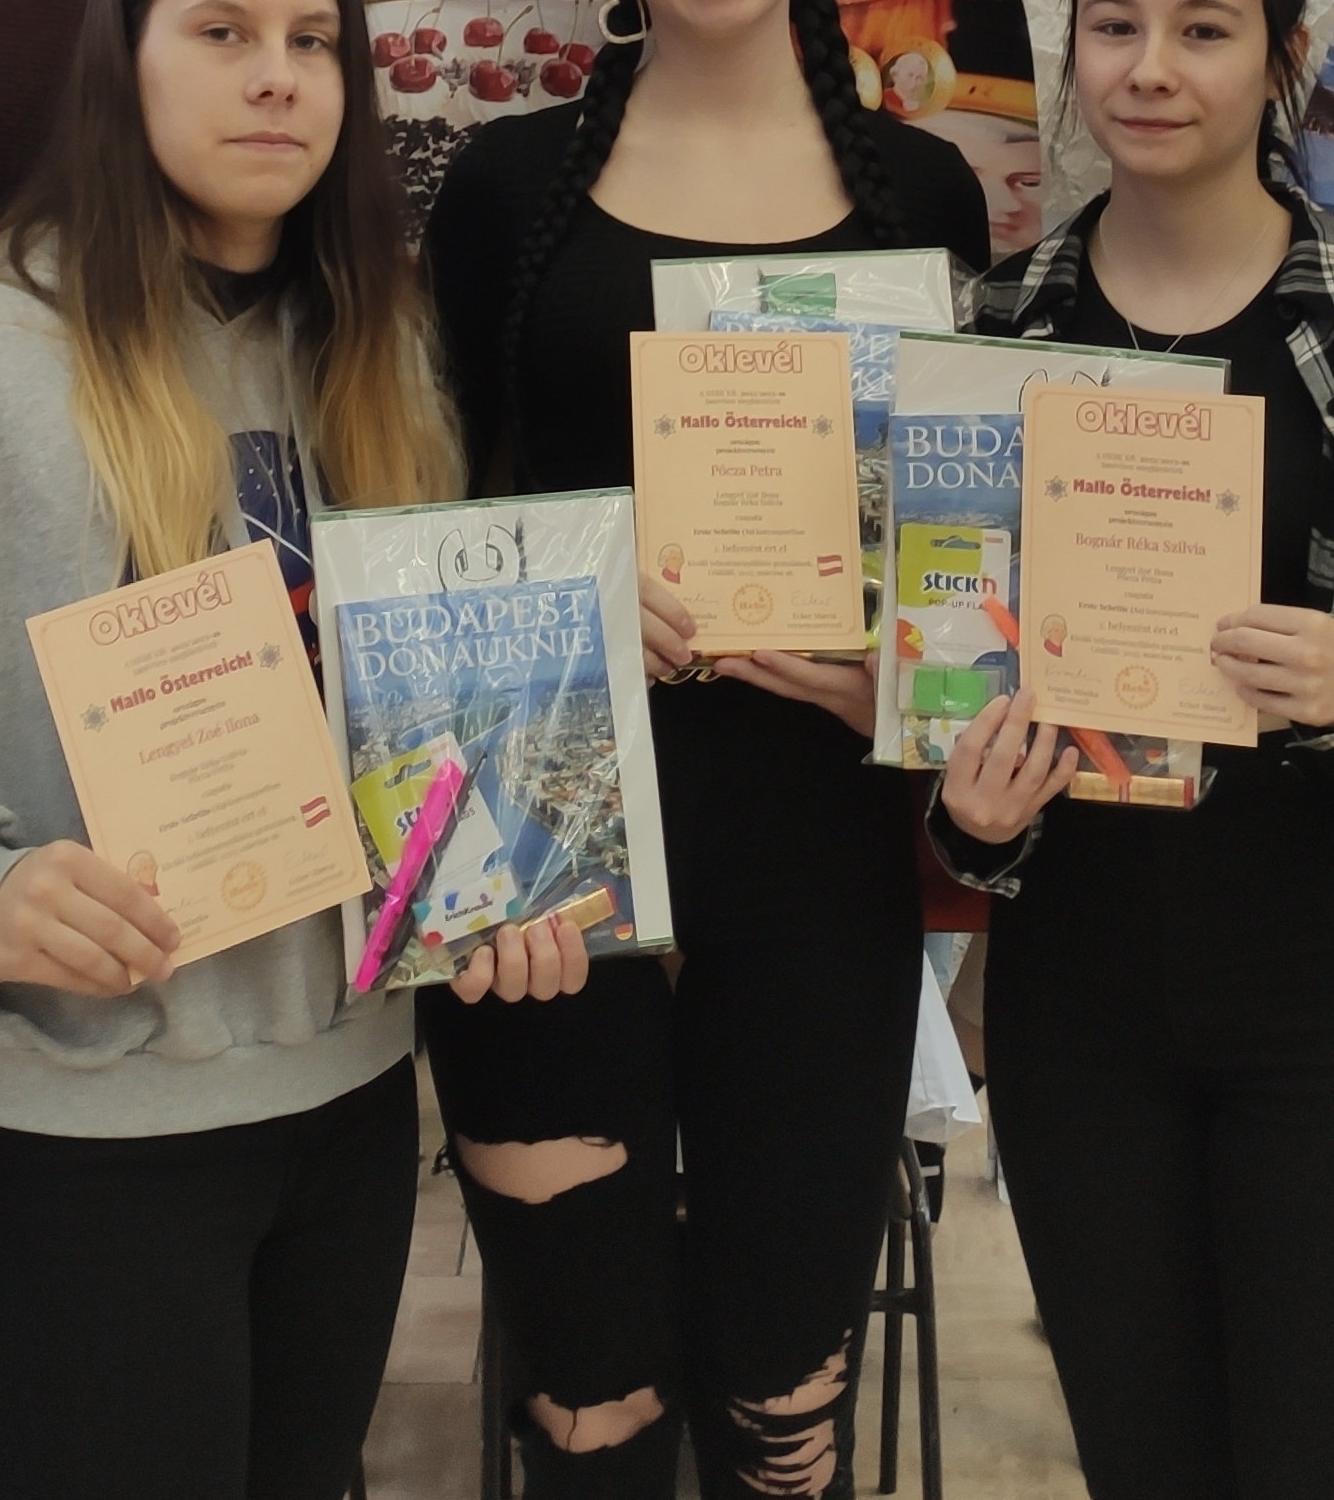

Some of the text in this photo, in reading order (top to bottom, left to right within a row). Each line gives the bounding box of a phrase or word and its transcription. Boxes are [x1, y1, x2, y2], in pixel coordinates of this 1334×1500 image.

[679, 339, 803, 374] Oklevél
[680, 411, 807, 428] Hallo Österreich!
[1075, 400, 1212, 441] Oklevél
[750, 464, 782, 477] Petra
[906, 461, 1021, 490] DONA
[1073, 477, 1211, 503] Hallo Österreich!
[1076, 533, 1206, 555] Bognár Réka Szilvia
[89, 570, 233, 646] Oklevél
[354, 587, 591, 648] BUDAPEST
[358, 626, 595, 681] DONAUKNIE
[110, 687, 156, 713] Hallo
[160, 651, 254, 695] Österreich!
